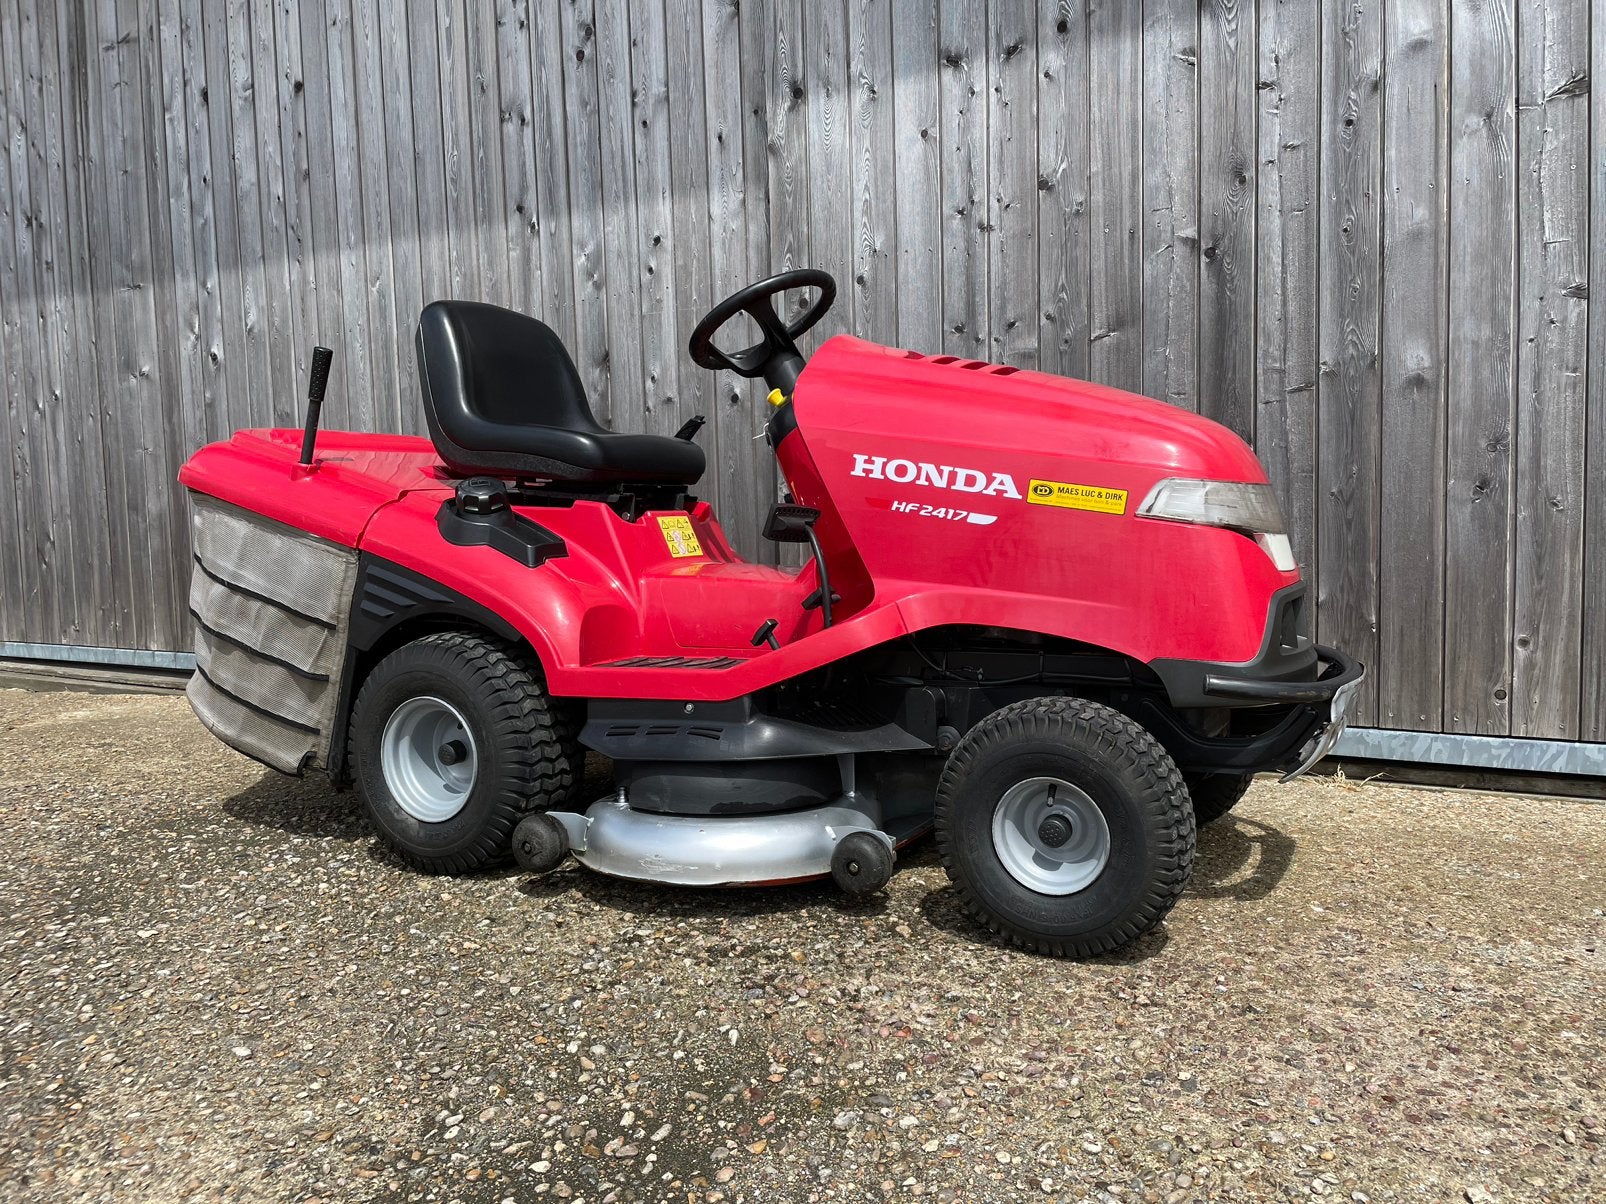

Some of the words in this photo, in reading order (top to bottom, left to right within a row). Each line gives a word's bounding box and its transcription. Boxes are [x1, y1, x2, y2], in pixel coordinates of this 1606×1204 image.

[850, 454, 1022, 499] HONDA
[1057, 486, 1079, 496] MAES
[1081, 489, 1096, 498] LUC
[1097, 491, 1104, 499] &
[1105, 492, 1124, 501] DIRK
[891, 500, 919, 512] HF
[919, 504, 968, 521] 2417
